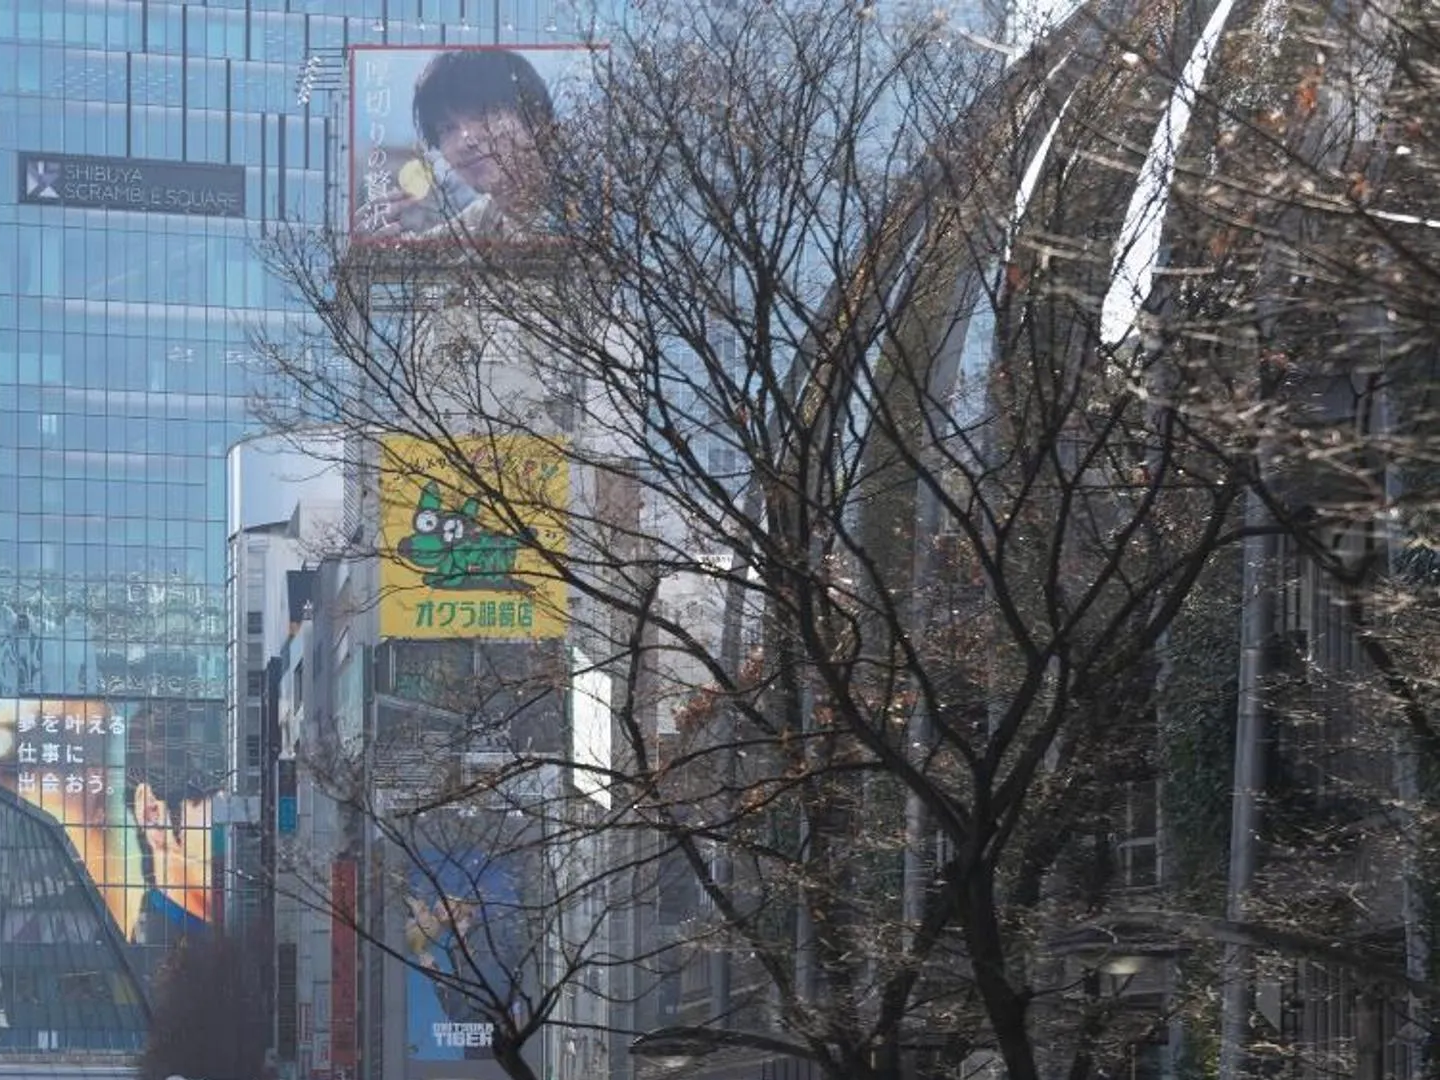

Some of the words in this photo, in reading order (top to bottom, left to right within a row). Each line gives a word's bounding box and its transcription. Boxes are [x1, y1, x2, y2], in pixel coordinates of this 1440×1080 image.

[65, 164, 143, 183] SHIBUYA
[64, 184, 161, 205] SCRAMBLE
[165, 189, 239, 208] SQUARE
[18, 713, 125, 735] 夢を叶える
[17, 742, 84, 763] 仕事に
[18, 772, 114, 795] 出会おう。
